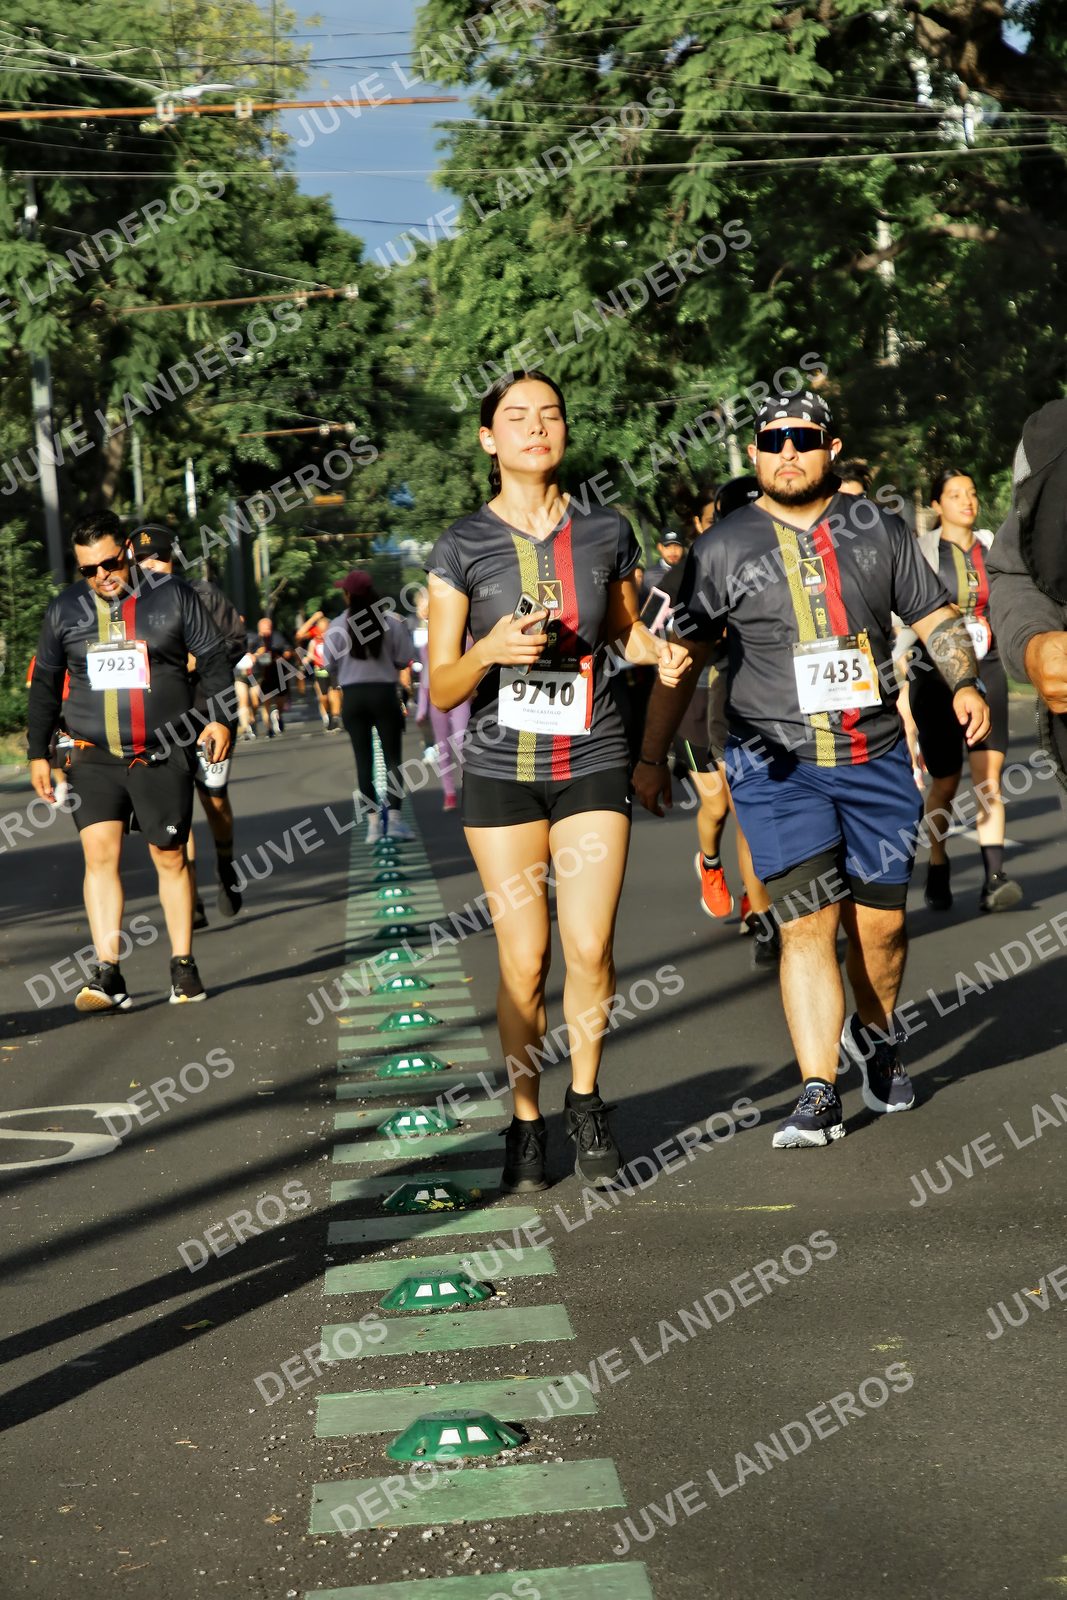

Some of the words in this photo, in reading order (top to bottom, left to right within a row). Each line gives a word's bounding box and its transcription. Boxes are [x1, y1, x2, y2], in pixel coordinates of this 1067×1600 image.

[97, 656, 135, 672] 7923
[807, 658, 862, 686] 7435
[512, 679, 575, 706] 9710
